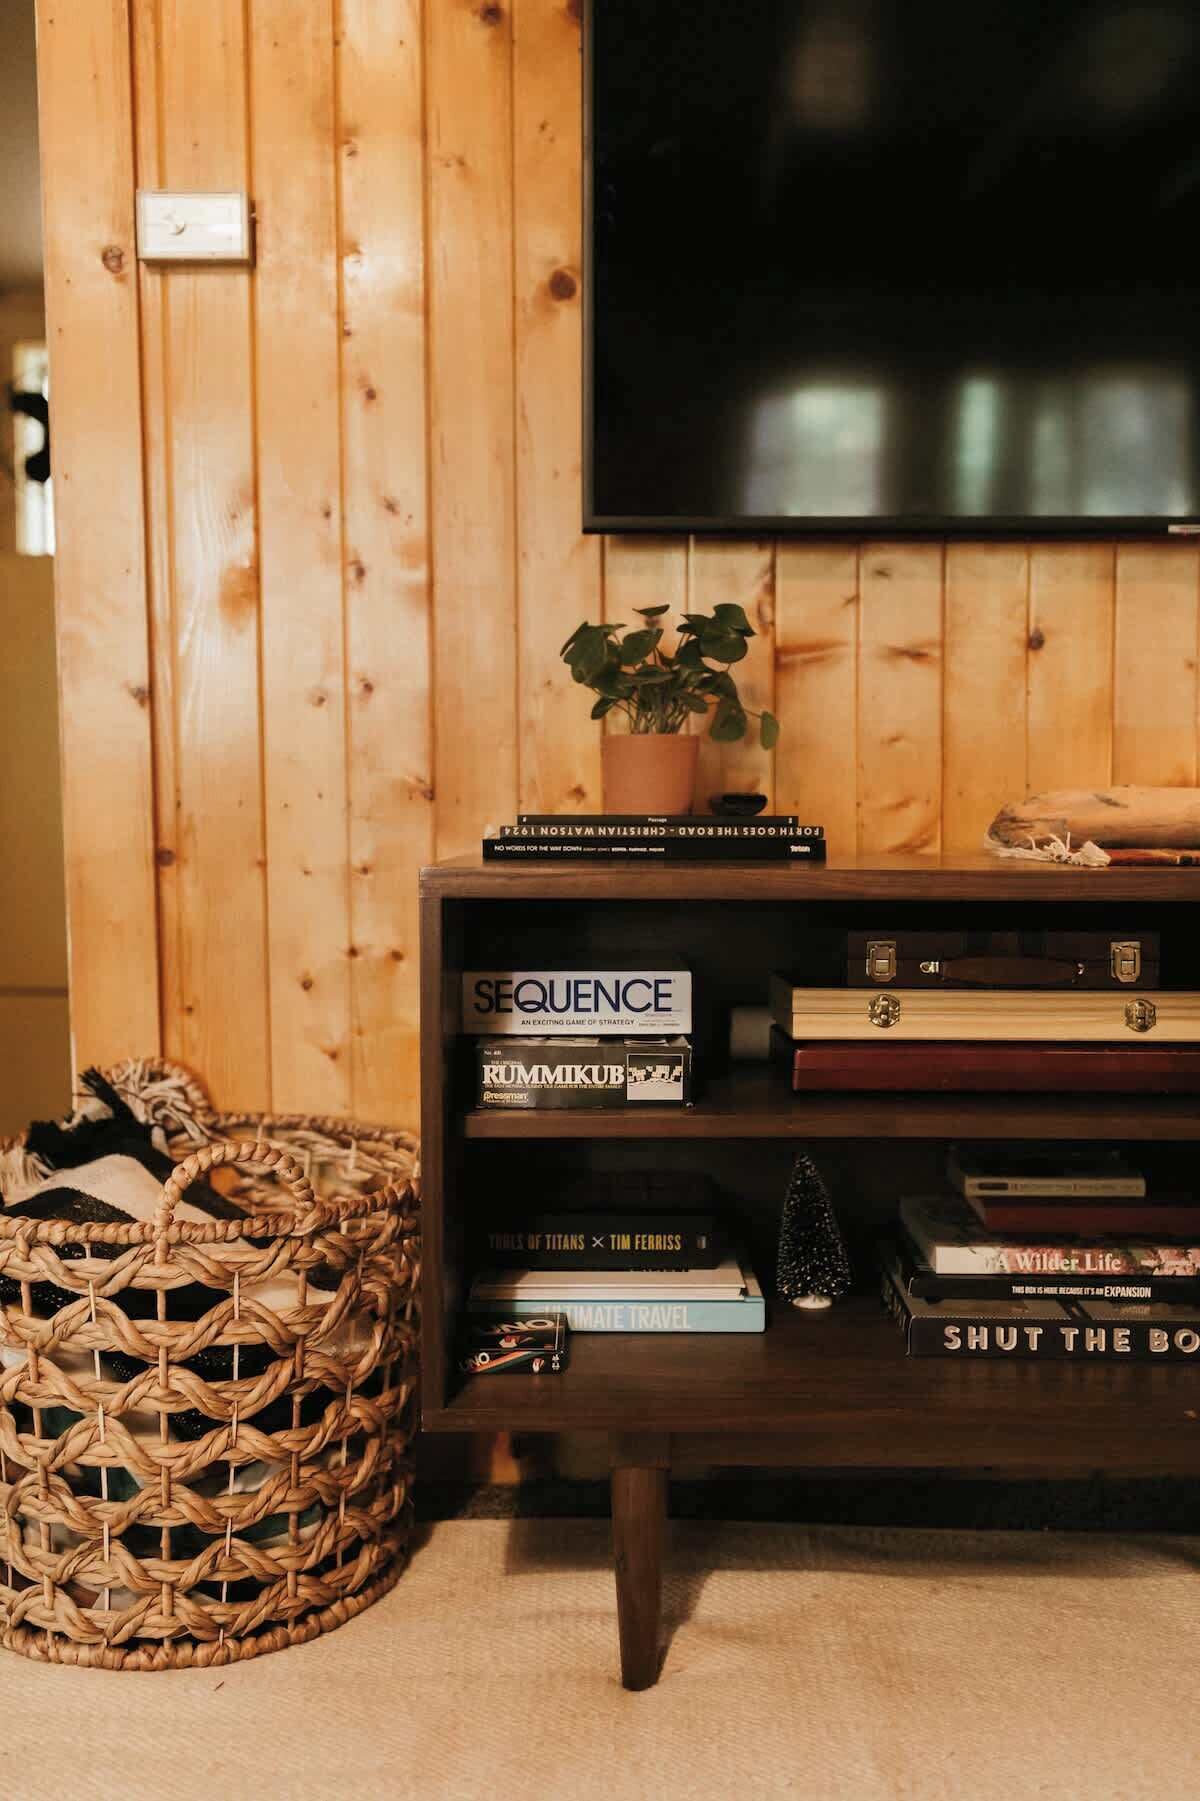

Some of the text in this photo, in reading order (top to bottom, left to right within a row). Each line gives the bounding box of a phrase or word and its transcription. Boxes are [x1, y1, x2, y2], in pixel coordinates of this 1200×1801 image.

[504, 827, 535, 836] 1924
[540, 827, 594, 836] WATSON
[598, 827, 666, 836] CHRISTIAN
[679, 827, 714, 836] ROAD
[717, 827, 739, 836] THE
[743, 827, 776, 836] GOES
[779, 827, 820, 836] FORTH
[474, 978, 672, 1014] SEQUENCE
[482, 1064, 625, 1085] RUMMIKUB
[527, 1233, 542, 1249] OF
[544, 1234, 585, 1250] TITANS
[610, 1234, 631, 1250] TIM
[635, 1234, 681, 1250] FERRISS
[996, 1253, 1122, 1271] A Wilder Life
[1012, 1286, 1024, 1294] THIS
[1024, 1286, 1036, 1294] BOX
[1036, 1286, 1043, 1295] IS
[1058, 1287, 1084, 1295] BECAUSE
[1084, 1287, 1095, 1296] IT'S
[1104, 1286, 1152, 1298] EXPANSION
[629, 1304, 692, 1329] TRAVEL
[943, 1325, 1043, 1351] SHUT
[1059, 1327, 1131, 1352] THE
